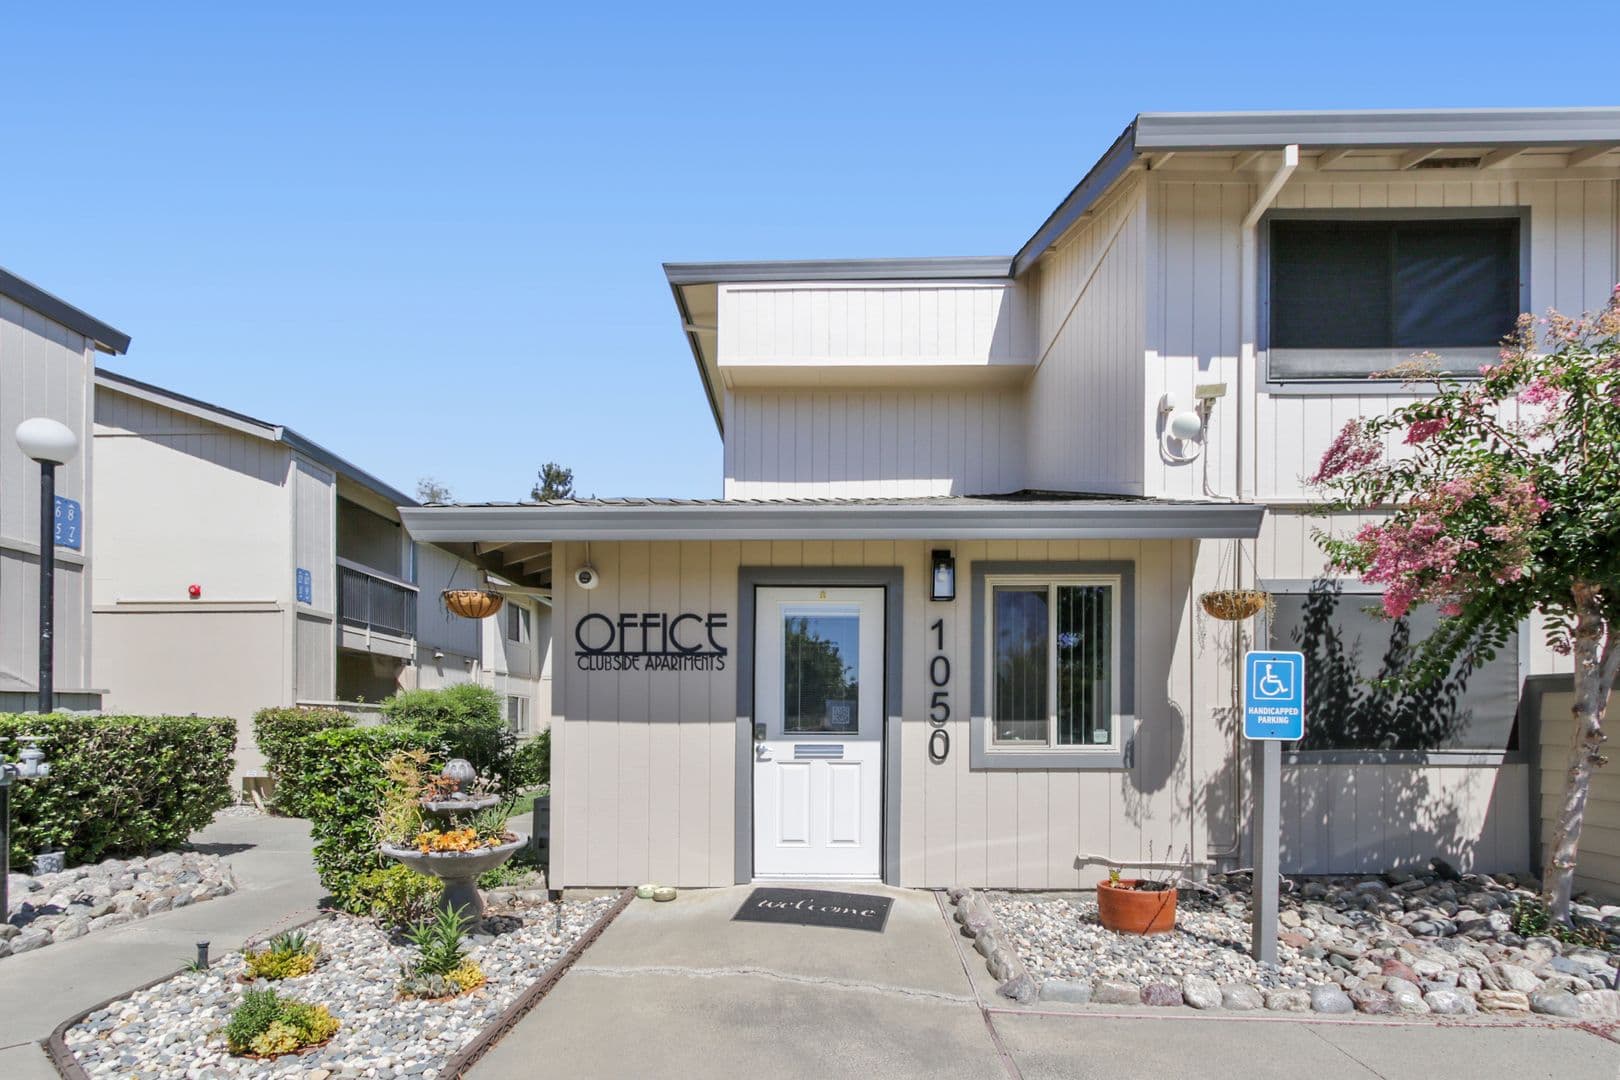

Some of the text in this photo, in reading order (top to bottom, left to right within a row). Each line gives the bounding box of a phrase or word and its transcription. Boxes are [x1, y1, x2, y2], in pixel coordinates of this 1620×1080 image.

[55, 506, 74, 521] 6 8
[56, 523, 75, 538] 5 7
[575, 613, 727, 653] OFFICE
[577, 655, 725, 671] CLUBSIDE APARTMENTS
[930, 618, 950, 760] 1050
[1248, 707, 1298, 715] HANDICAPPED
[1258, 716, 1289, 724] PARKING
